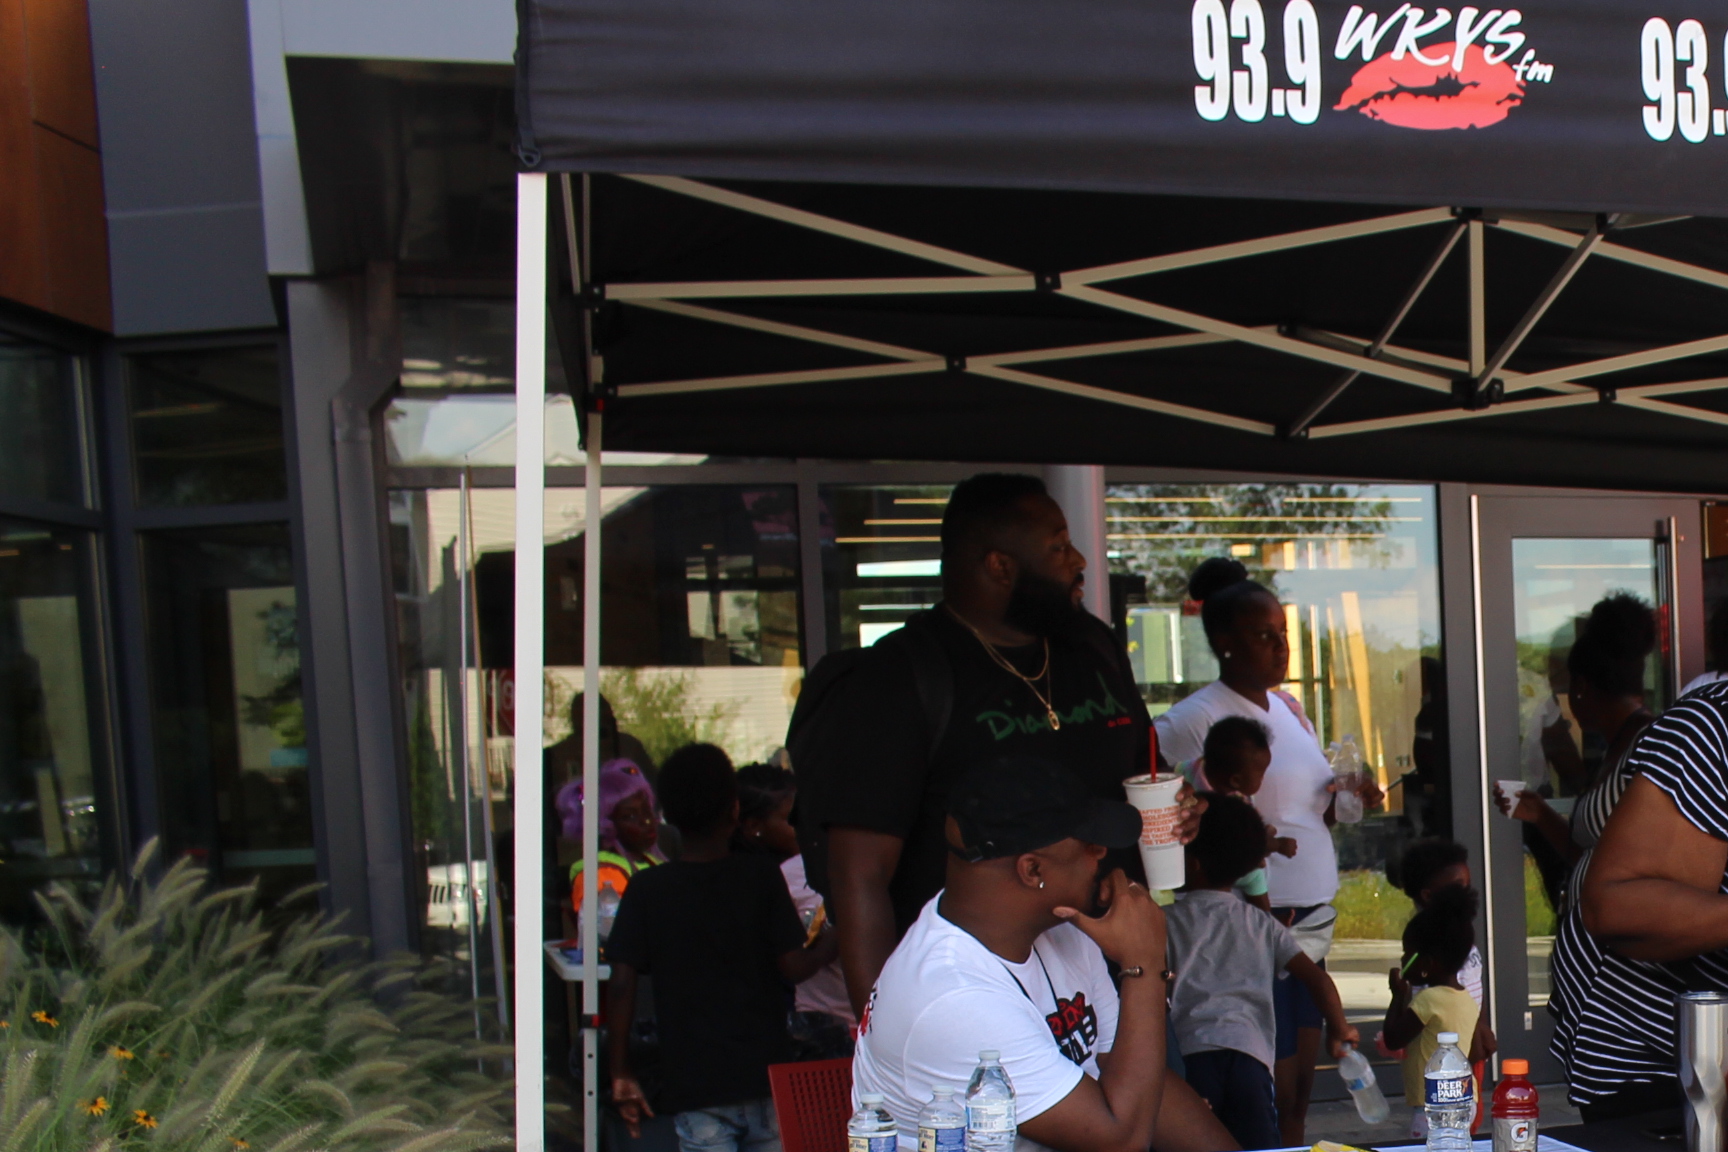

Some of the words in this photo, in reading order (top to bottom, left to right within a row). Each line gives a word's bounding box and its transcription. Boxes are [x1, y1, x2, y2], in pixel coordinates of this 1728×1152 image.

[1191, 0, 1321, 124] 93.9
[1334, 3, 1526, 72] WKYS
[1512, 49, 1554, 84] fm
[1437, 1080, 1462, 1090] DEER
[1438, 1090, 1463, 1098] PARK
[1511, 1122, 1528, 1143] G
